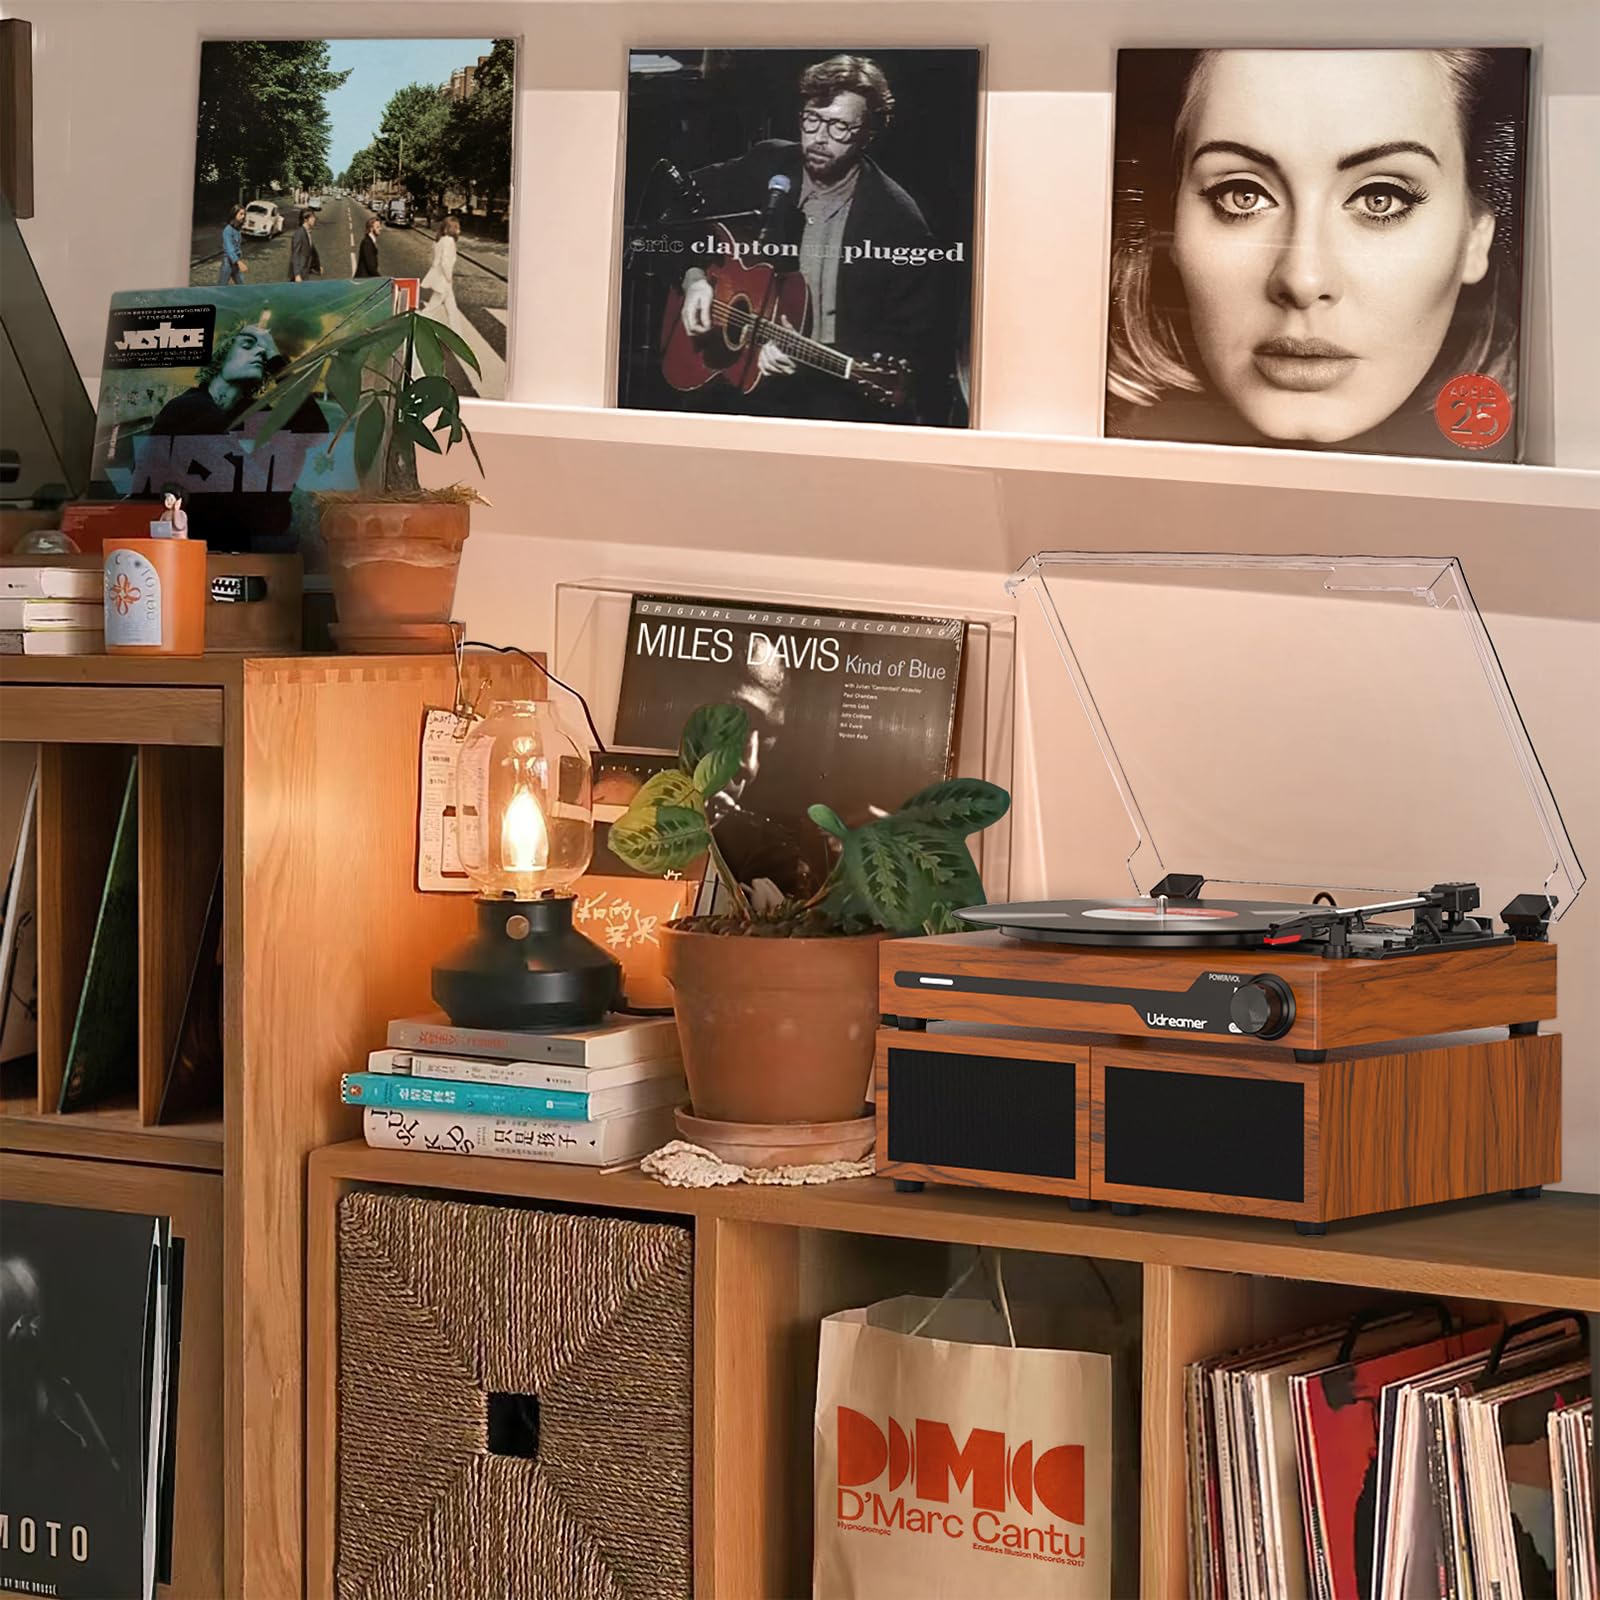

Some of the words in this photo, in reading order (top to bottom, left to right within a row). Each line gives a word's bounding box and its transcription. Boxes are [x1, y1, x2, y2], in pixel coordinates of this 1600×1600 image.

[630, 233, 684, 252] eric
[690, 234, 798, 260] clapton
[1450, 400, 1499, 436] 25
[641, 604, 732, 619] ORIGINAL
[748, 613, 821, 627] MASTER
[838, 621, 946, 637] RECORDING
[636, 622, 734, 663] MILES
[746, 632, 840, 672] DAVIS
[845, 654, 882, 676] Kind
[887, 661, 906, 677] of
[908, 658, 946, 681] Blue
[1208, 973, 1240, 984] POWER/VOL
[1146, 1012, 1208, 1030] Udreamer
[424, 1125, 475, 1155] KIDS
[493, 1129, 578, 1149] 只是孩子
[837, 1487, 964, 1539] D'Marc
[972, 1510, 1085, 1559] Cantu
[837, 1520, 892, 1537] Hypnopompic
[972, 1542, 1003, 1555] Endless
[1003, 1547, 1032, 1560] Illusion
[1032, 1552, 1066, 1565] Records
[1066, 1558, 1085, 1568] 2017
